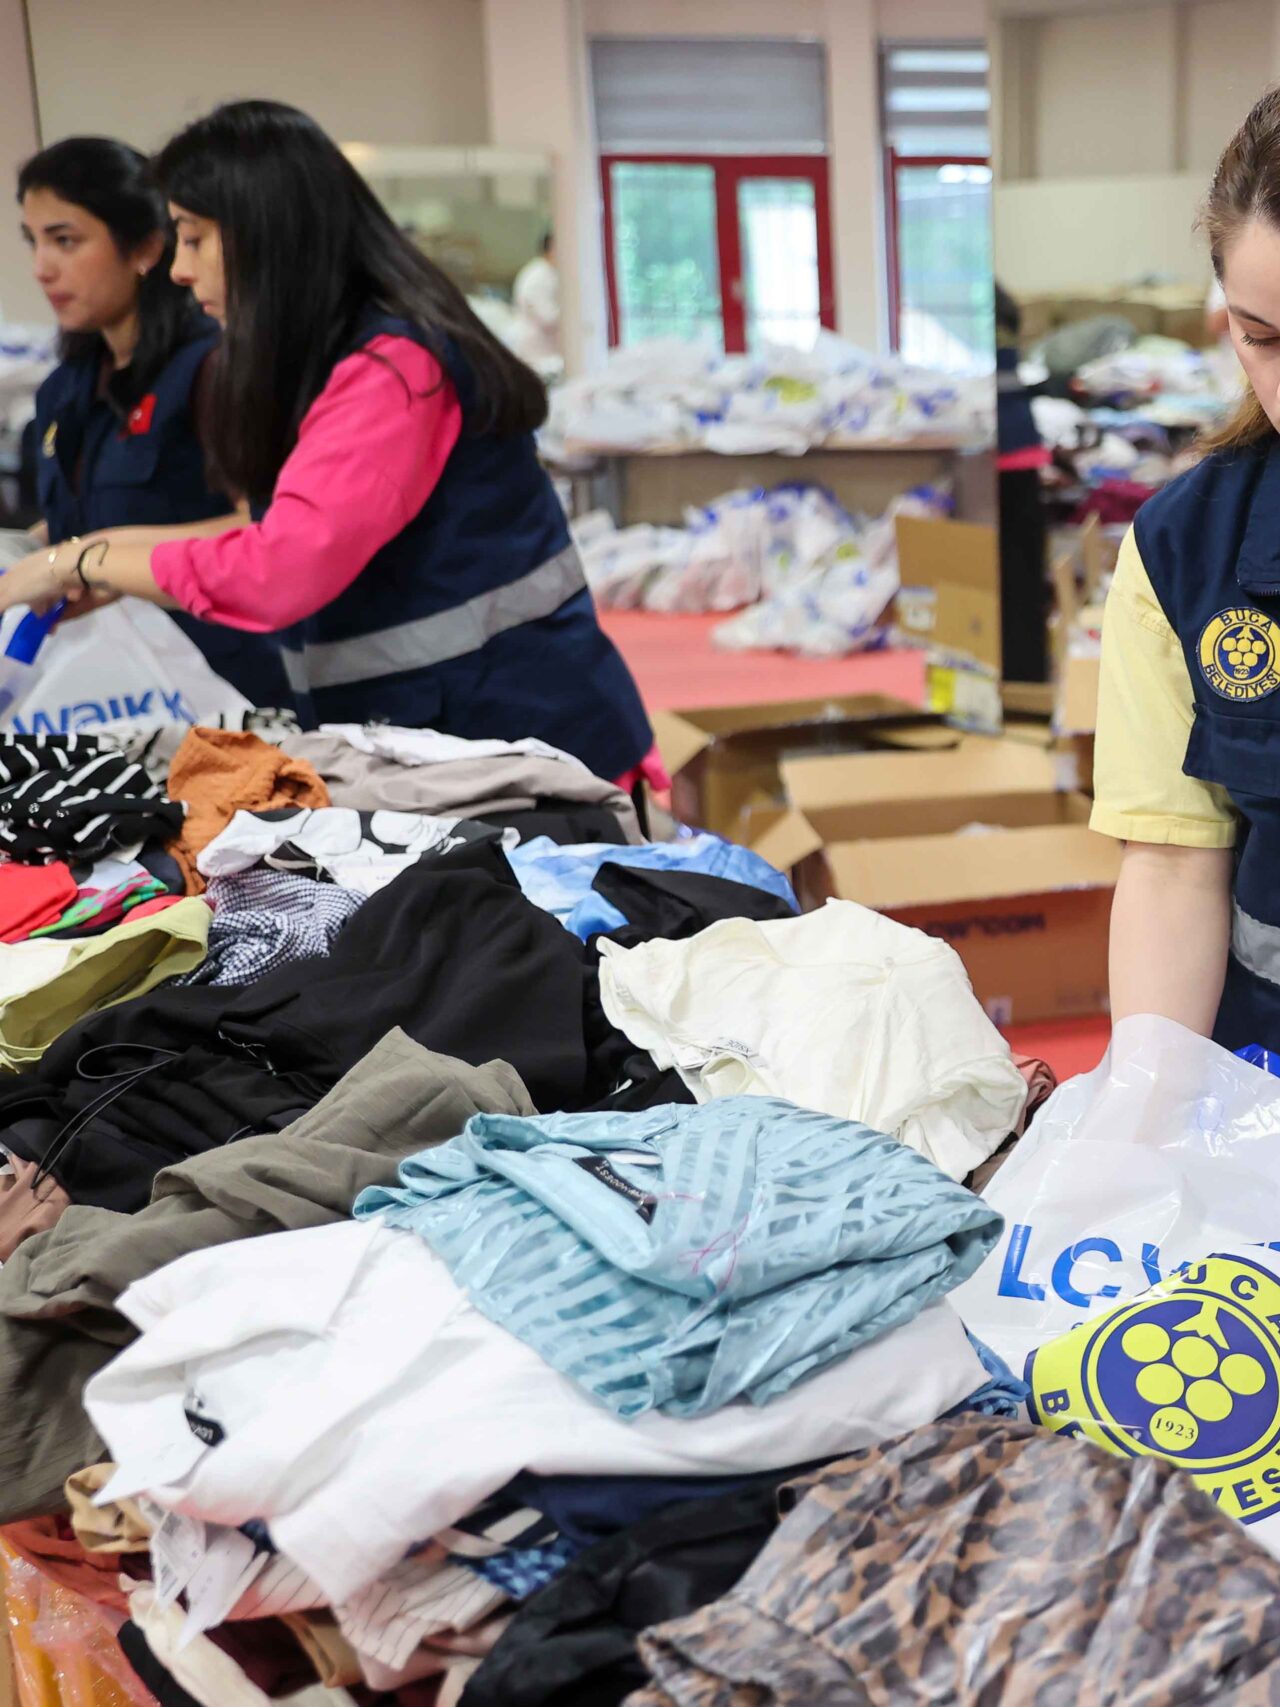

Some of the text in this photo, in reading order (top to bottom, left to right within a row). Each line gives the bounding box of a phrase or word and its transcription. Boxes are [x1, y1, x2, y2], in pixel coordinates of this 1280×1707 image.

[1221, 609, 1273, 634] BUCA
[997, 1224, 1123, 1308] LC
[1155, 1417, 1195, 1440] 1923
